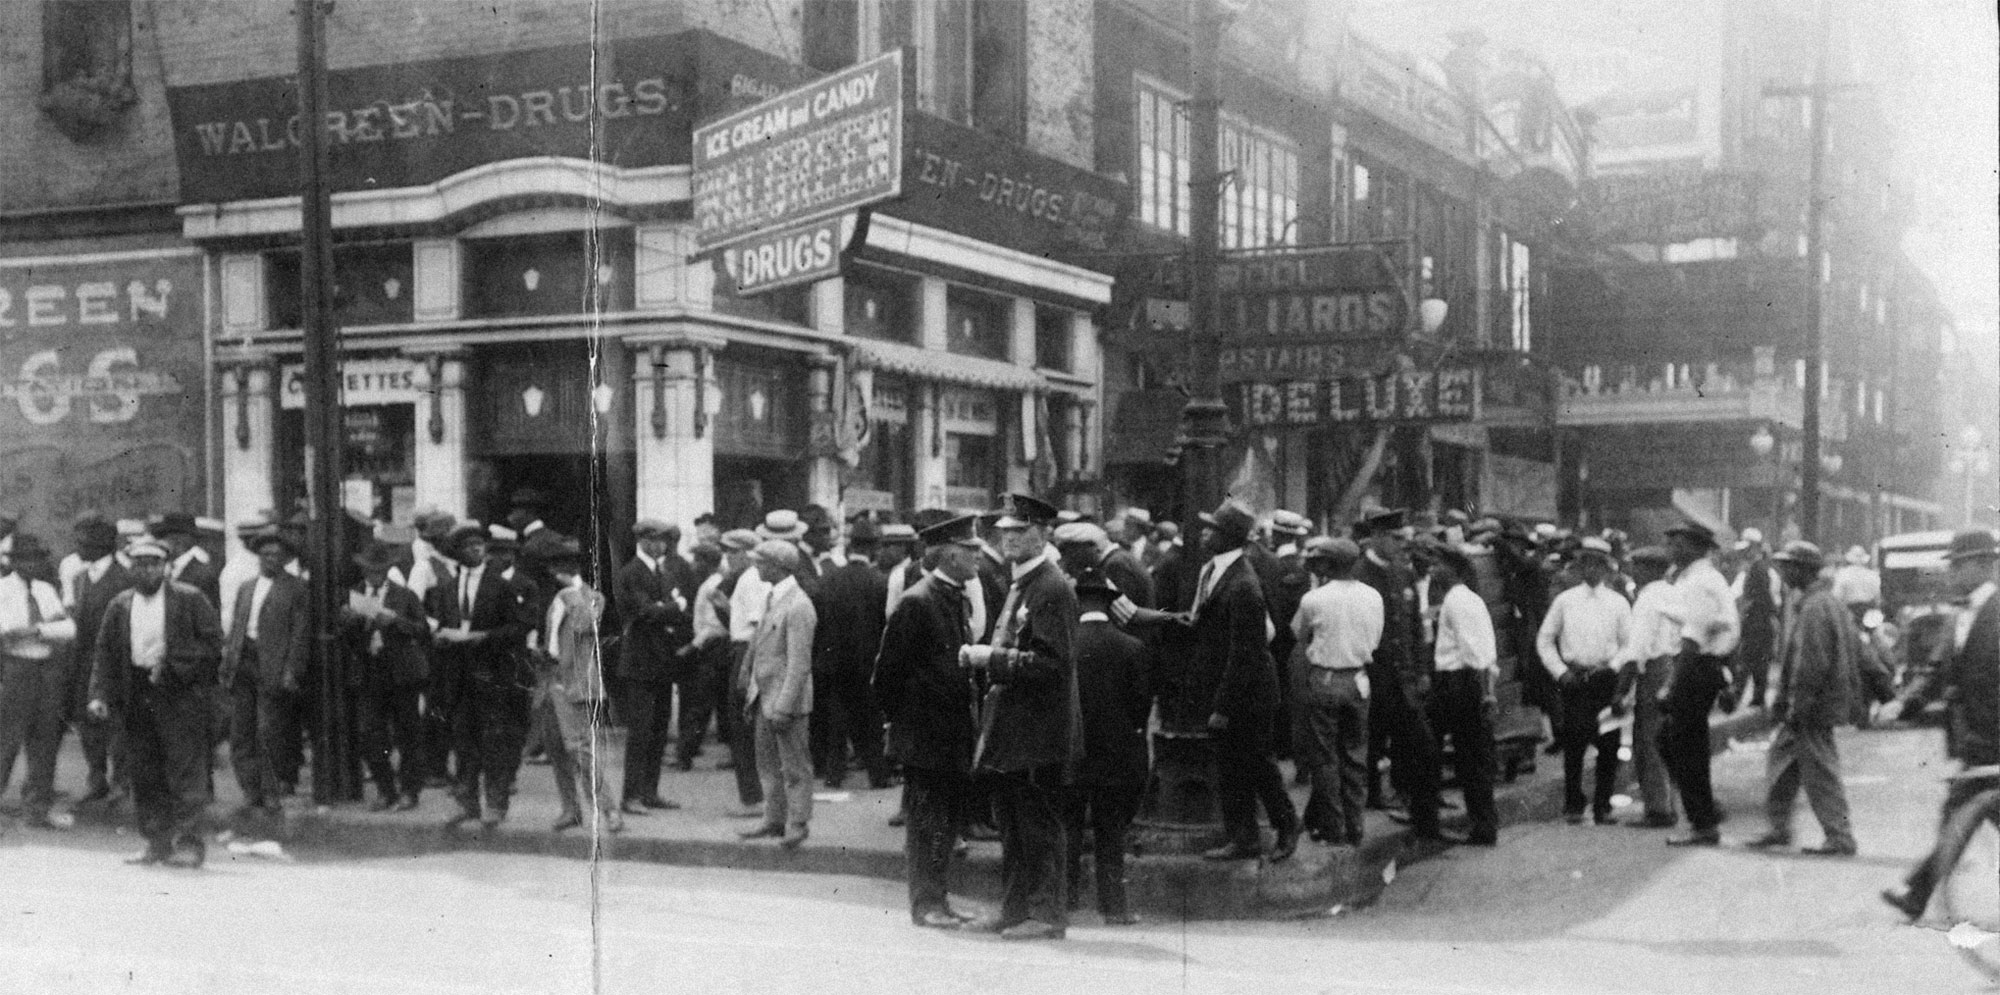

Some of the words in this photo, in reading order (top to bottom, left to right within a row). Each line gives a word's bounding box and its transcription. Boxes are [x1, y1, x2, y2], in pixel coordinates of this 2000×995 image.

[705, 129, 731, 160] ICE
[731, 104, 790, 150] CREAM
[813, 69, 880, 119] CANDY
[743, 227, 832, 286] DRUGS
[1218, 344, 1345, 375] PSTAIRS
